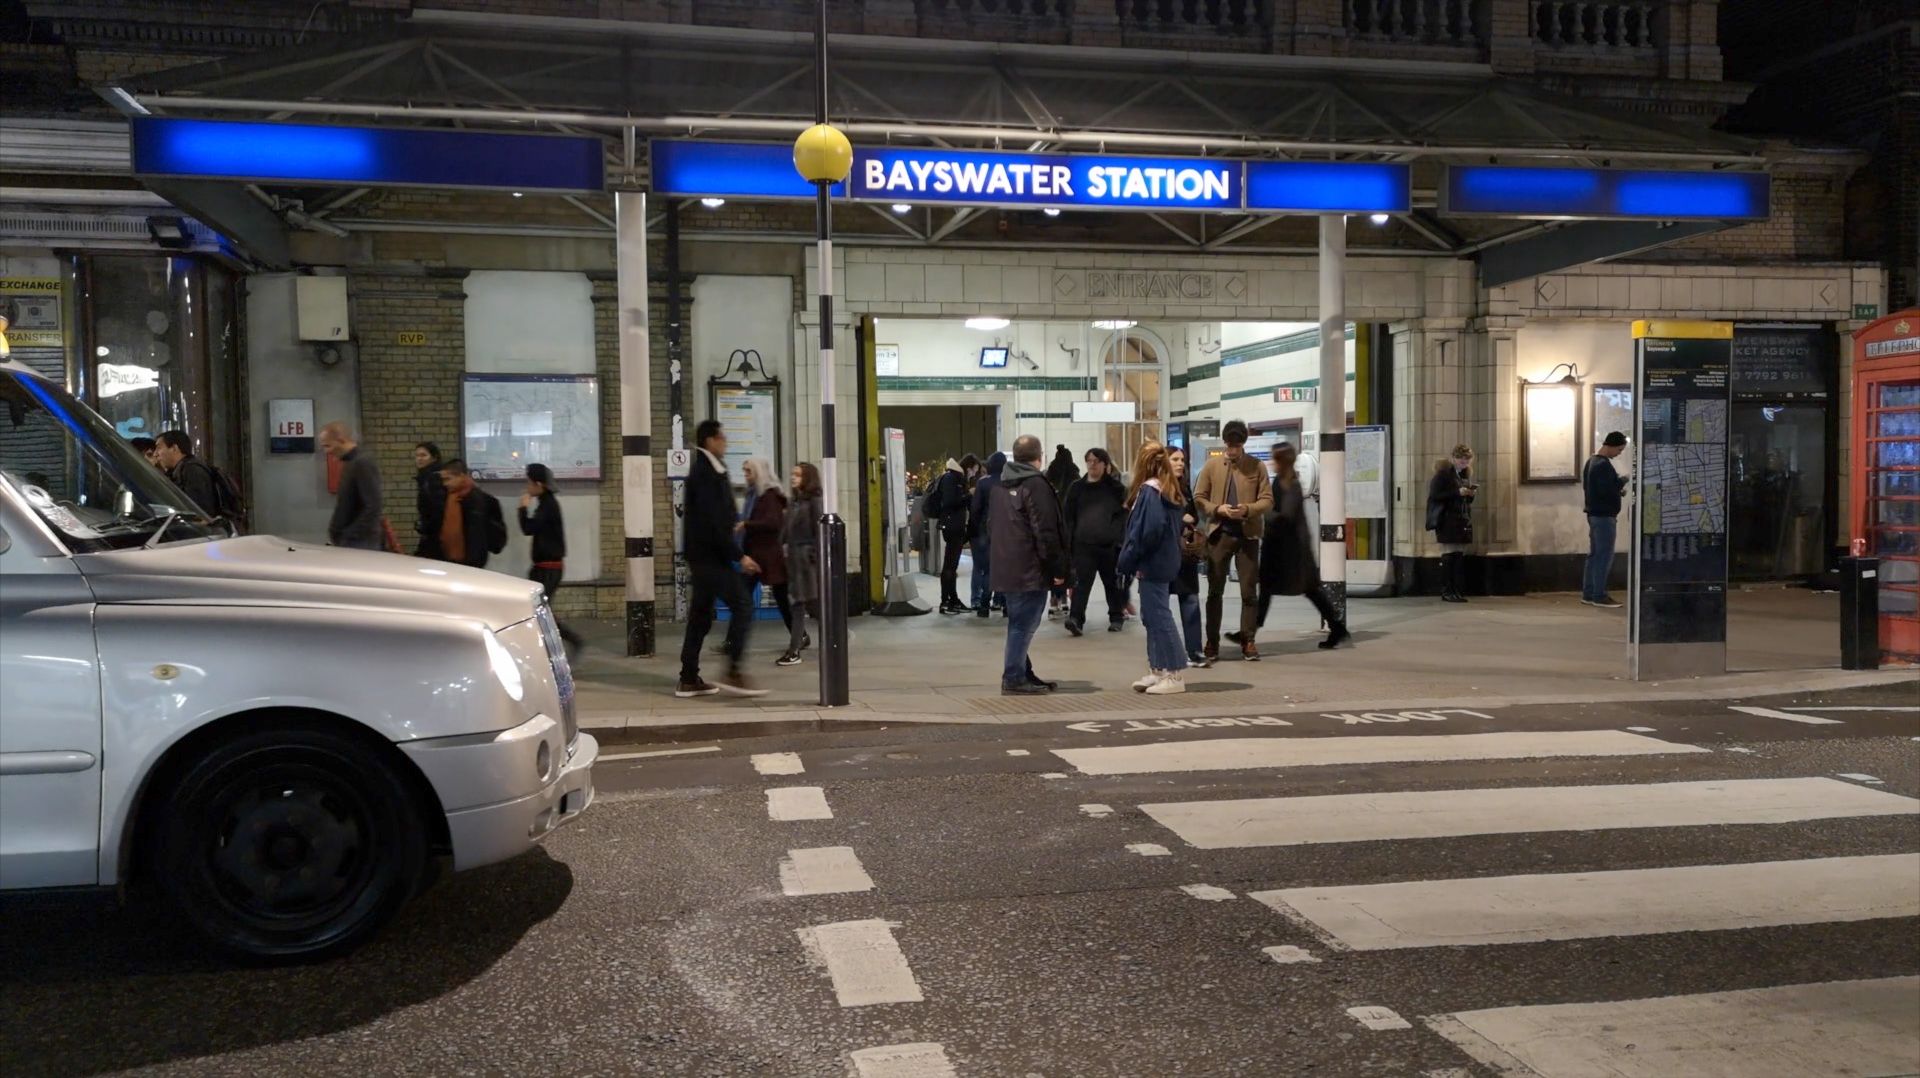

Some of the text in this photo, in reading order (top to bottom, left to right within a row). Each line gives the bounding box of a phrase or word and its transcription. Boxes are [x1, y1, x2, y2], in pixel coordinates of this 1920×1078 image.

[865, 159, 1229, 200] BAYSWATER STATION
[0, 281, 60, 290] EXCHANGE
[1087, 270, 1213, 299] ENTRANCE
[400, 334, 424, 343] RVP
[1761, 347, 1809, 355] AGENCY
[1745, 371, 1778, 380] 7792
[279, 422, 304, 435] LFB
[1123, 709, 1496, 732] LOOK RIGHT
